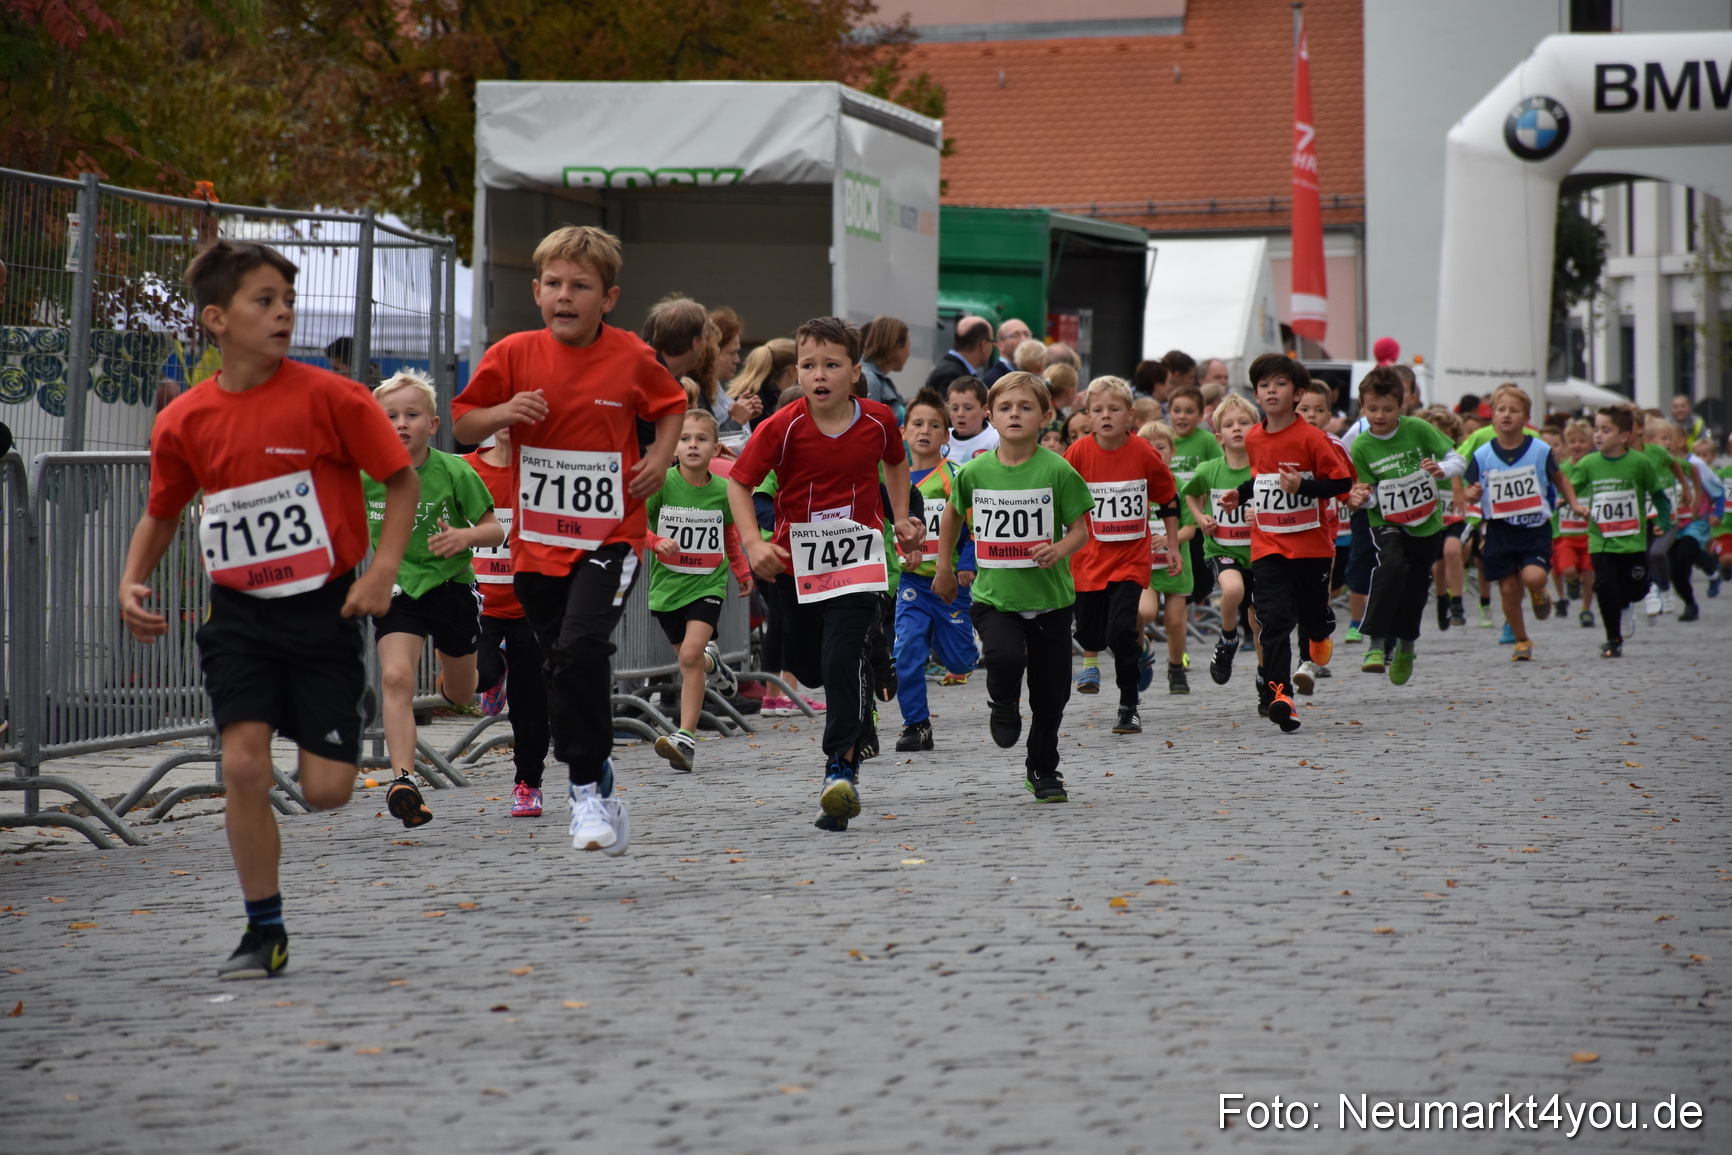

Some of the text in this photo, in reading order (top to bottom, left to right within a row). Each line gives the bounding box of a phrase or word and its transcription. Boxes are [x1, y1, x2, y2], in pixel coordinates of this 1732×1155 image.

[523, 456, 606, 472] PARTL Neumarkt
[1110, 486, 1139, 494] Neumarkt
[1379, 475, 1424, 491] PARTL Neumarkt
[1493, 478, 1535, 500] 7402
[206, 489, 292, 516] PARTL Neumarkt
[975, 497, 996, 505] PARTL
[660, 515, 684, 523] PARTL
[821, 512, 841, 520] DEHN
[1595, 501, 1633, 522] 7041
[557, 519, 582, 535] Erik
[1101, 524, 1139, 533] Johannes
[1278, 516, 1296, 525] Luis
[666, 525, 719, 550] 7078
[792, 524, 864, 538] PARTL Neumarkt
[801, 534, 874, 571] 7427
[988, 546, 1033, 557] Matthia
[680, 555, 703, 566] Marc
[247, 564, 294, 586] Julian
[815, 574, 852, 592] Luis
